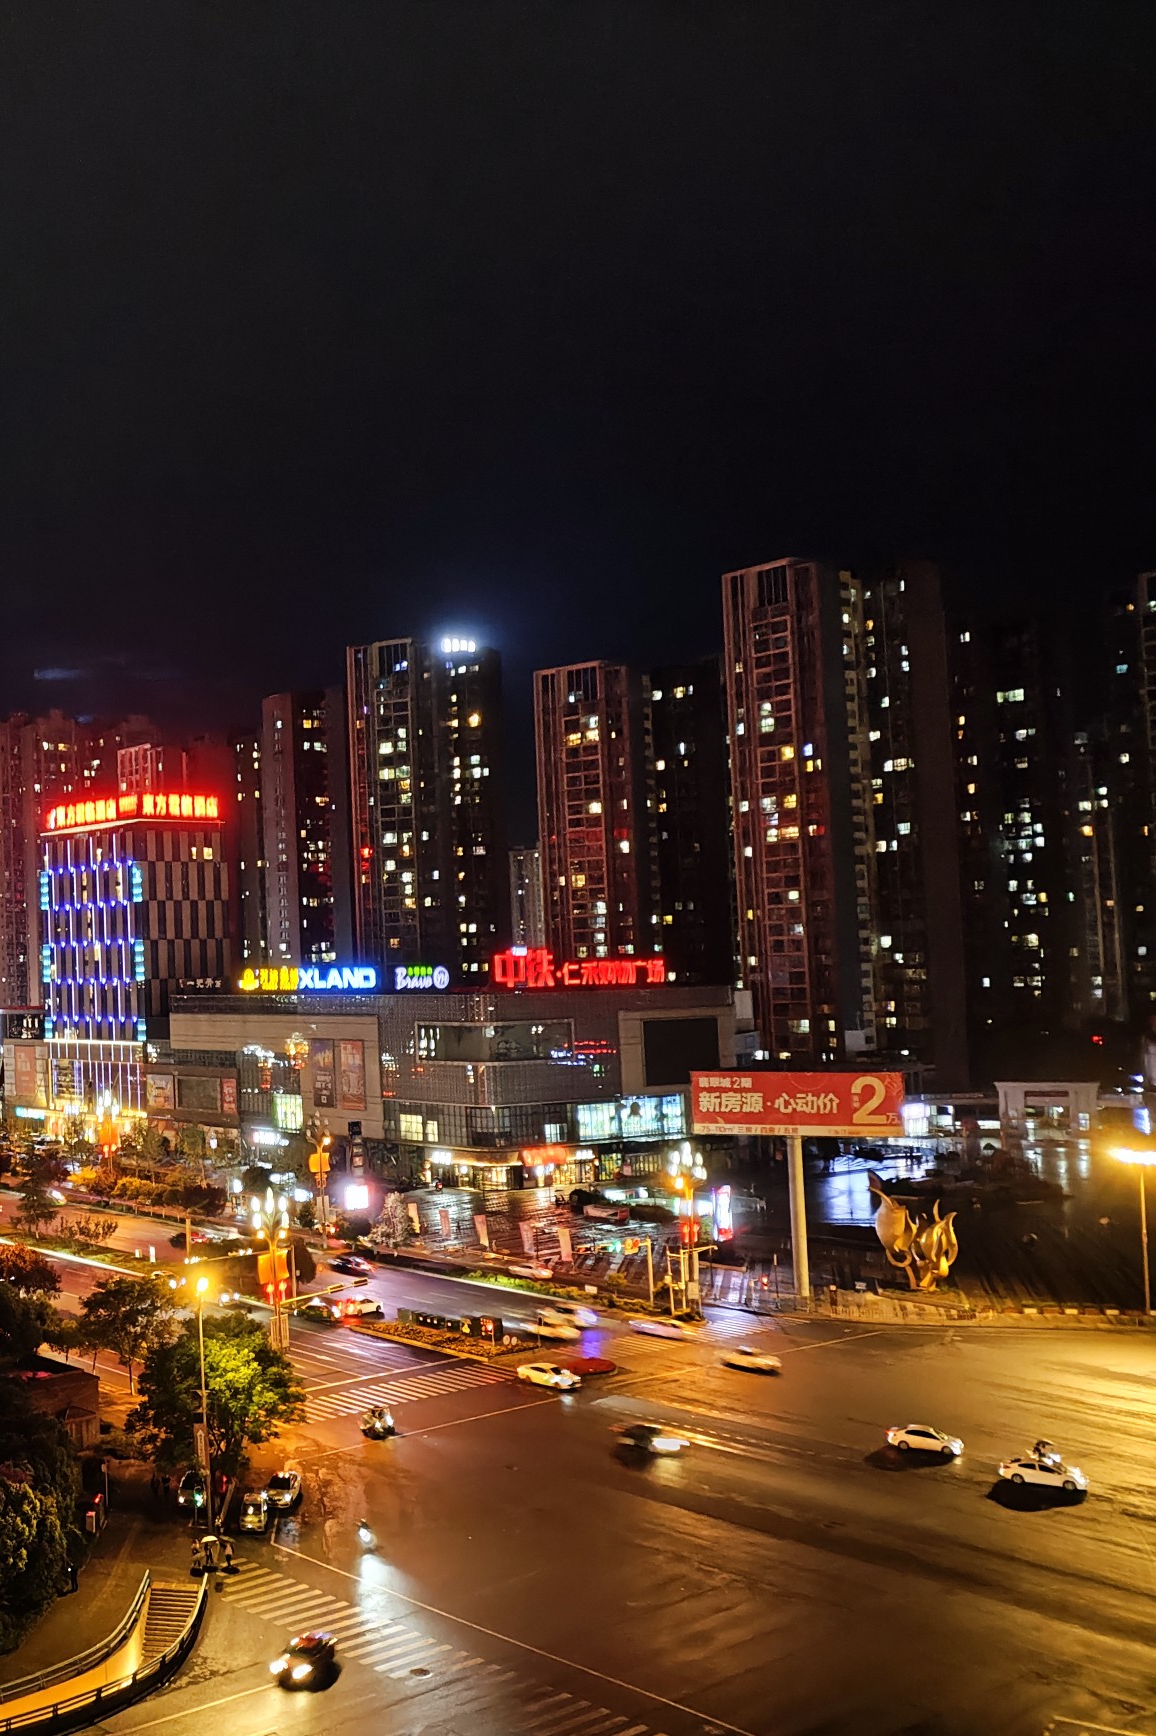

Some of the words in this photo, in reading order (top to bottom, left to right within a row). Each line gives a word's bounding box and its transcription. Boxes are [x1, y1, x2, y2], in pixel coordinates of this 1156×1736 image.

[395, 967, 433, 990] Bravo
[698, 1092, 840, 1114] 新房源·心动价
